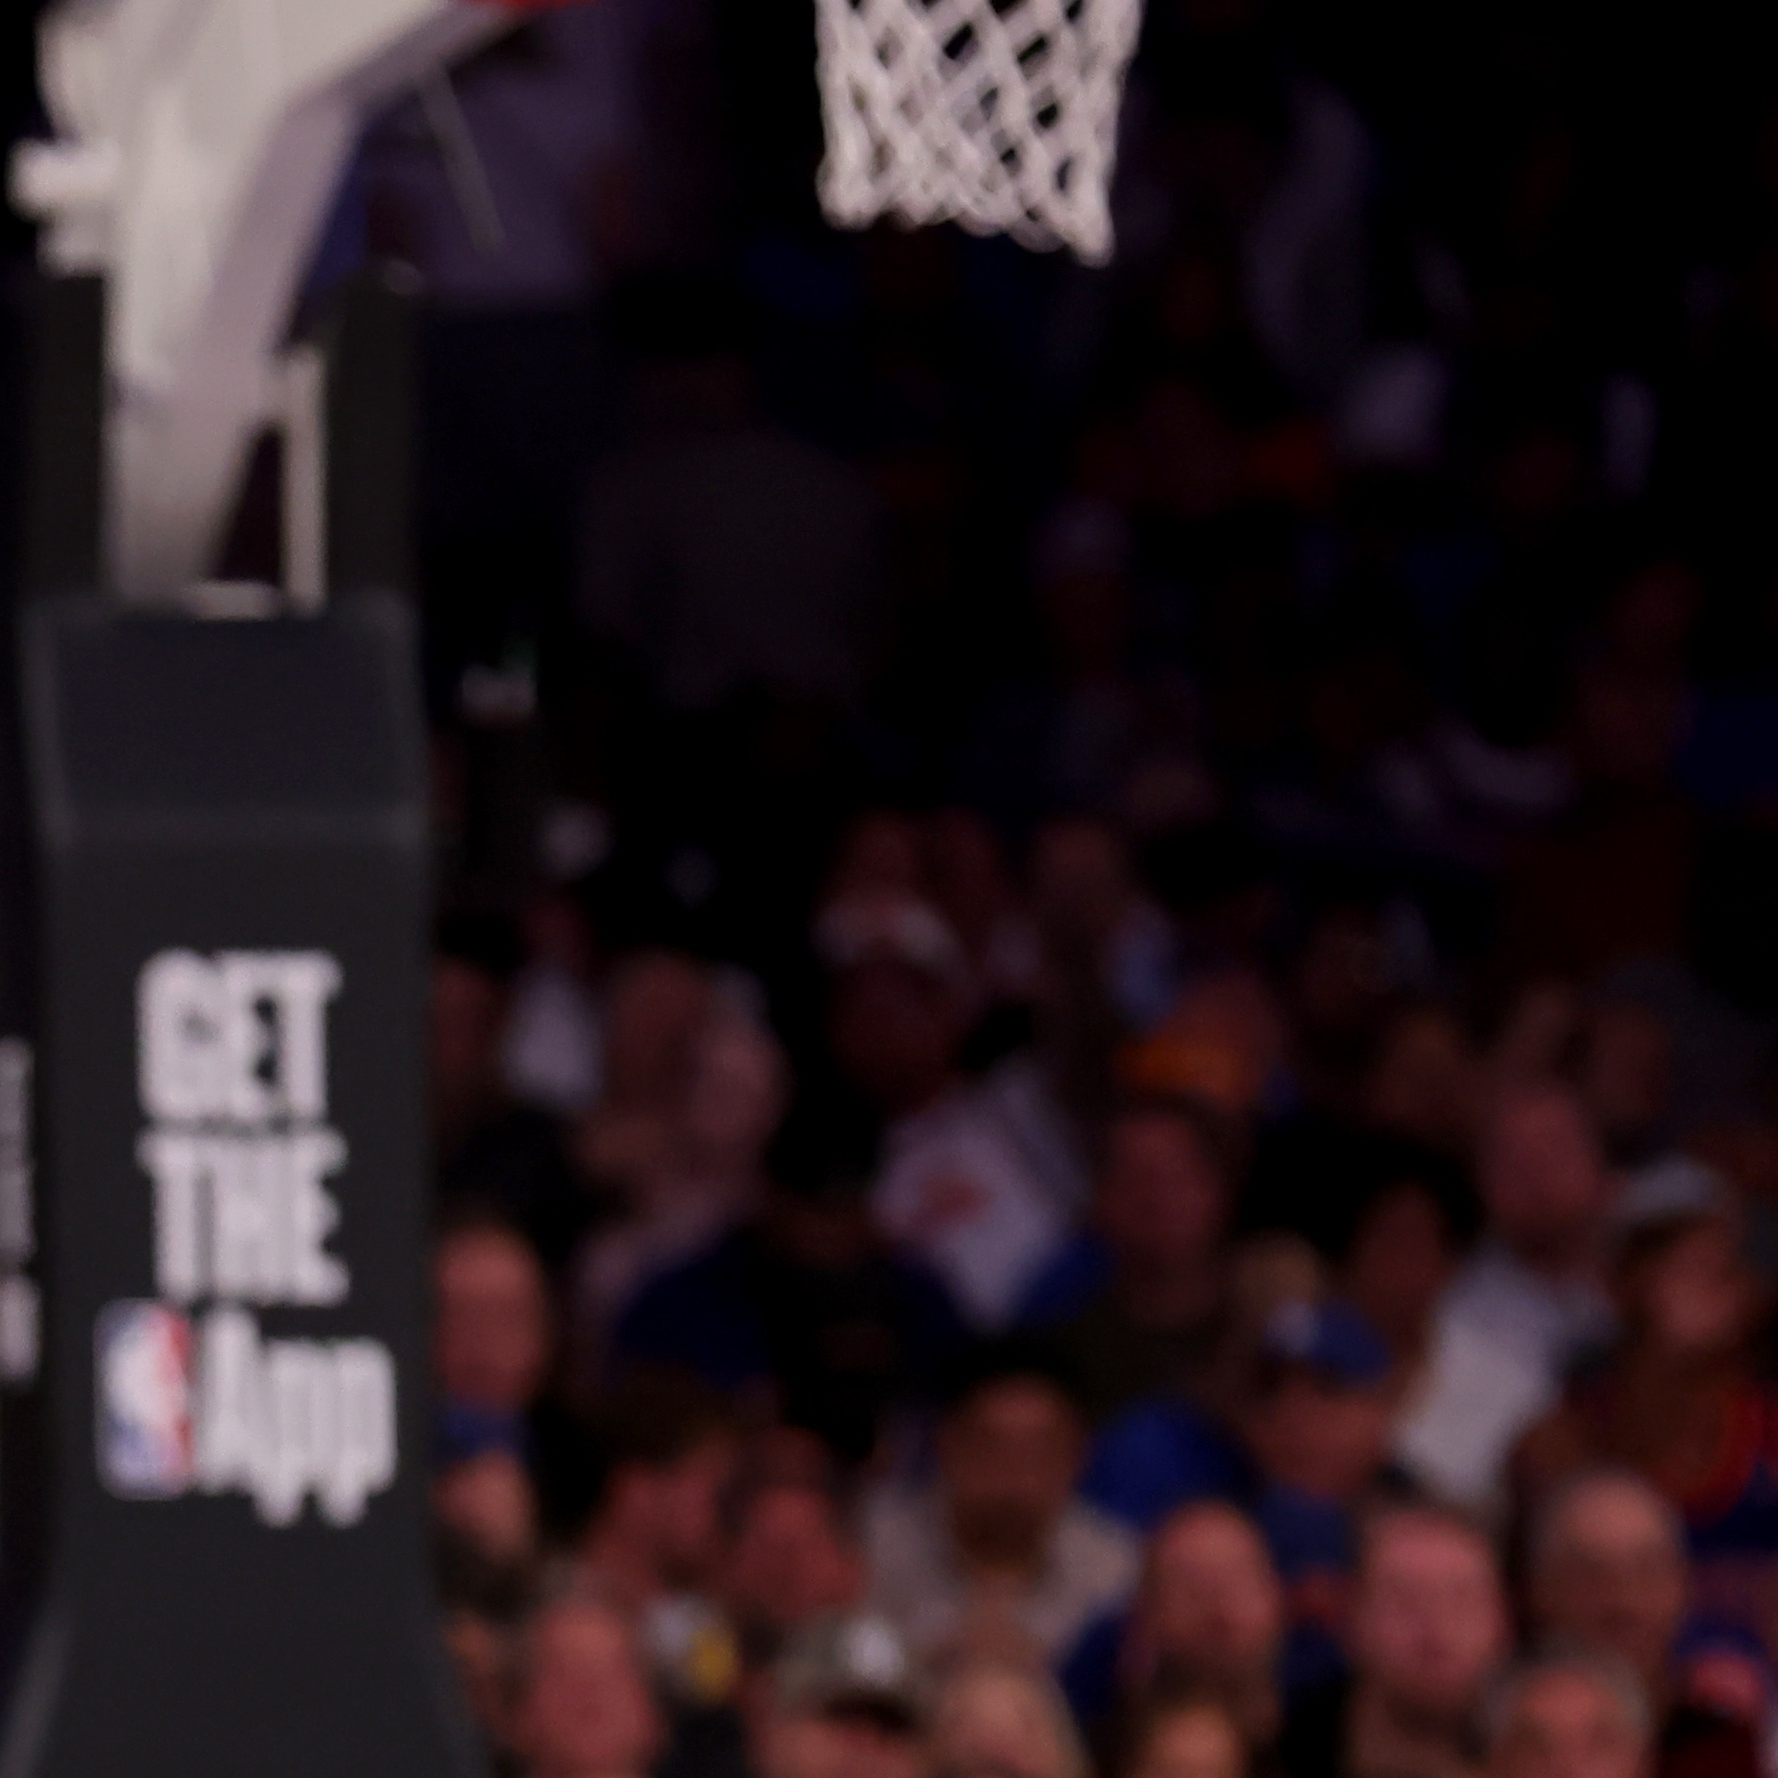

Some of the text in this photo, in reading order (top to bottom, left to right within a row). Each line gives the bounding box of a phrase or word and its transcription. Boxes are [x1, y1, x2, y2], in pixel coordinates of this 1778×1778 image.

[135, 949, 343, 1117] GET
[135, 1130, 349, 1307] THE
[194, 1306, 398, 1528] App
